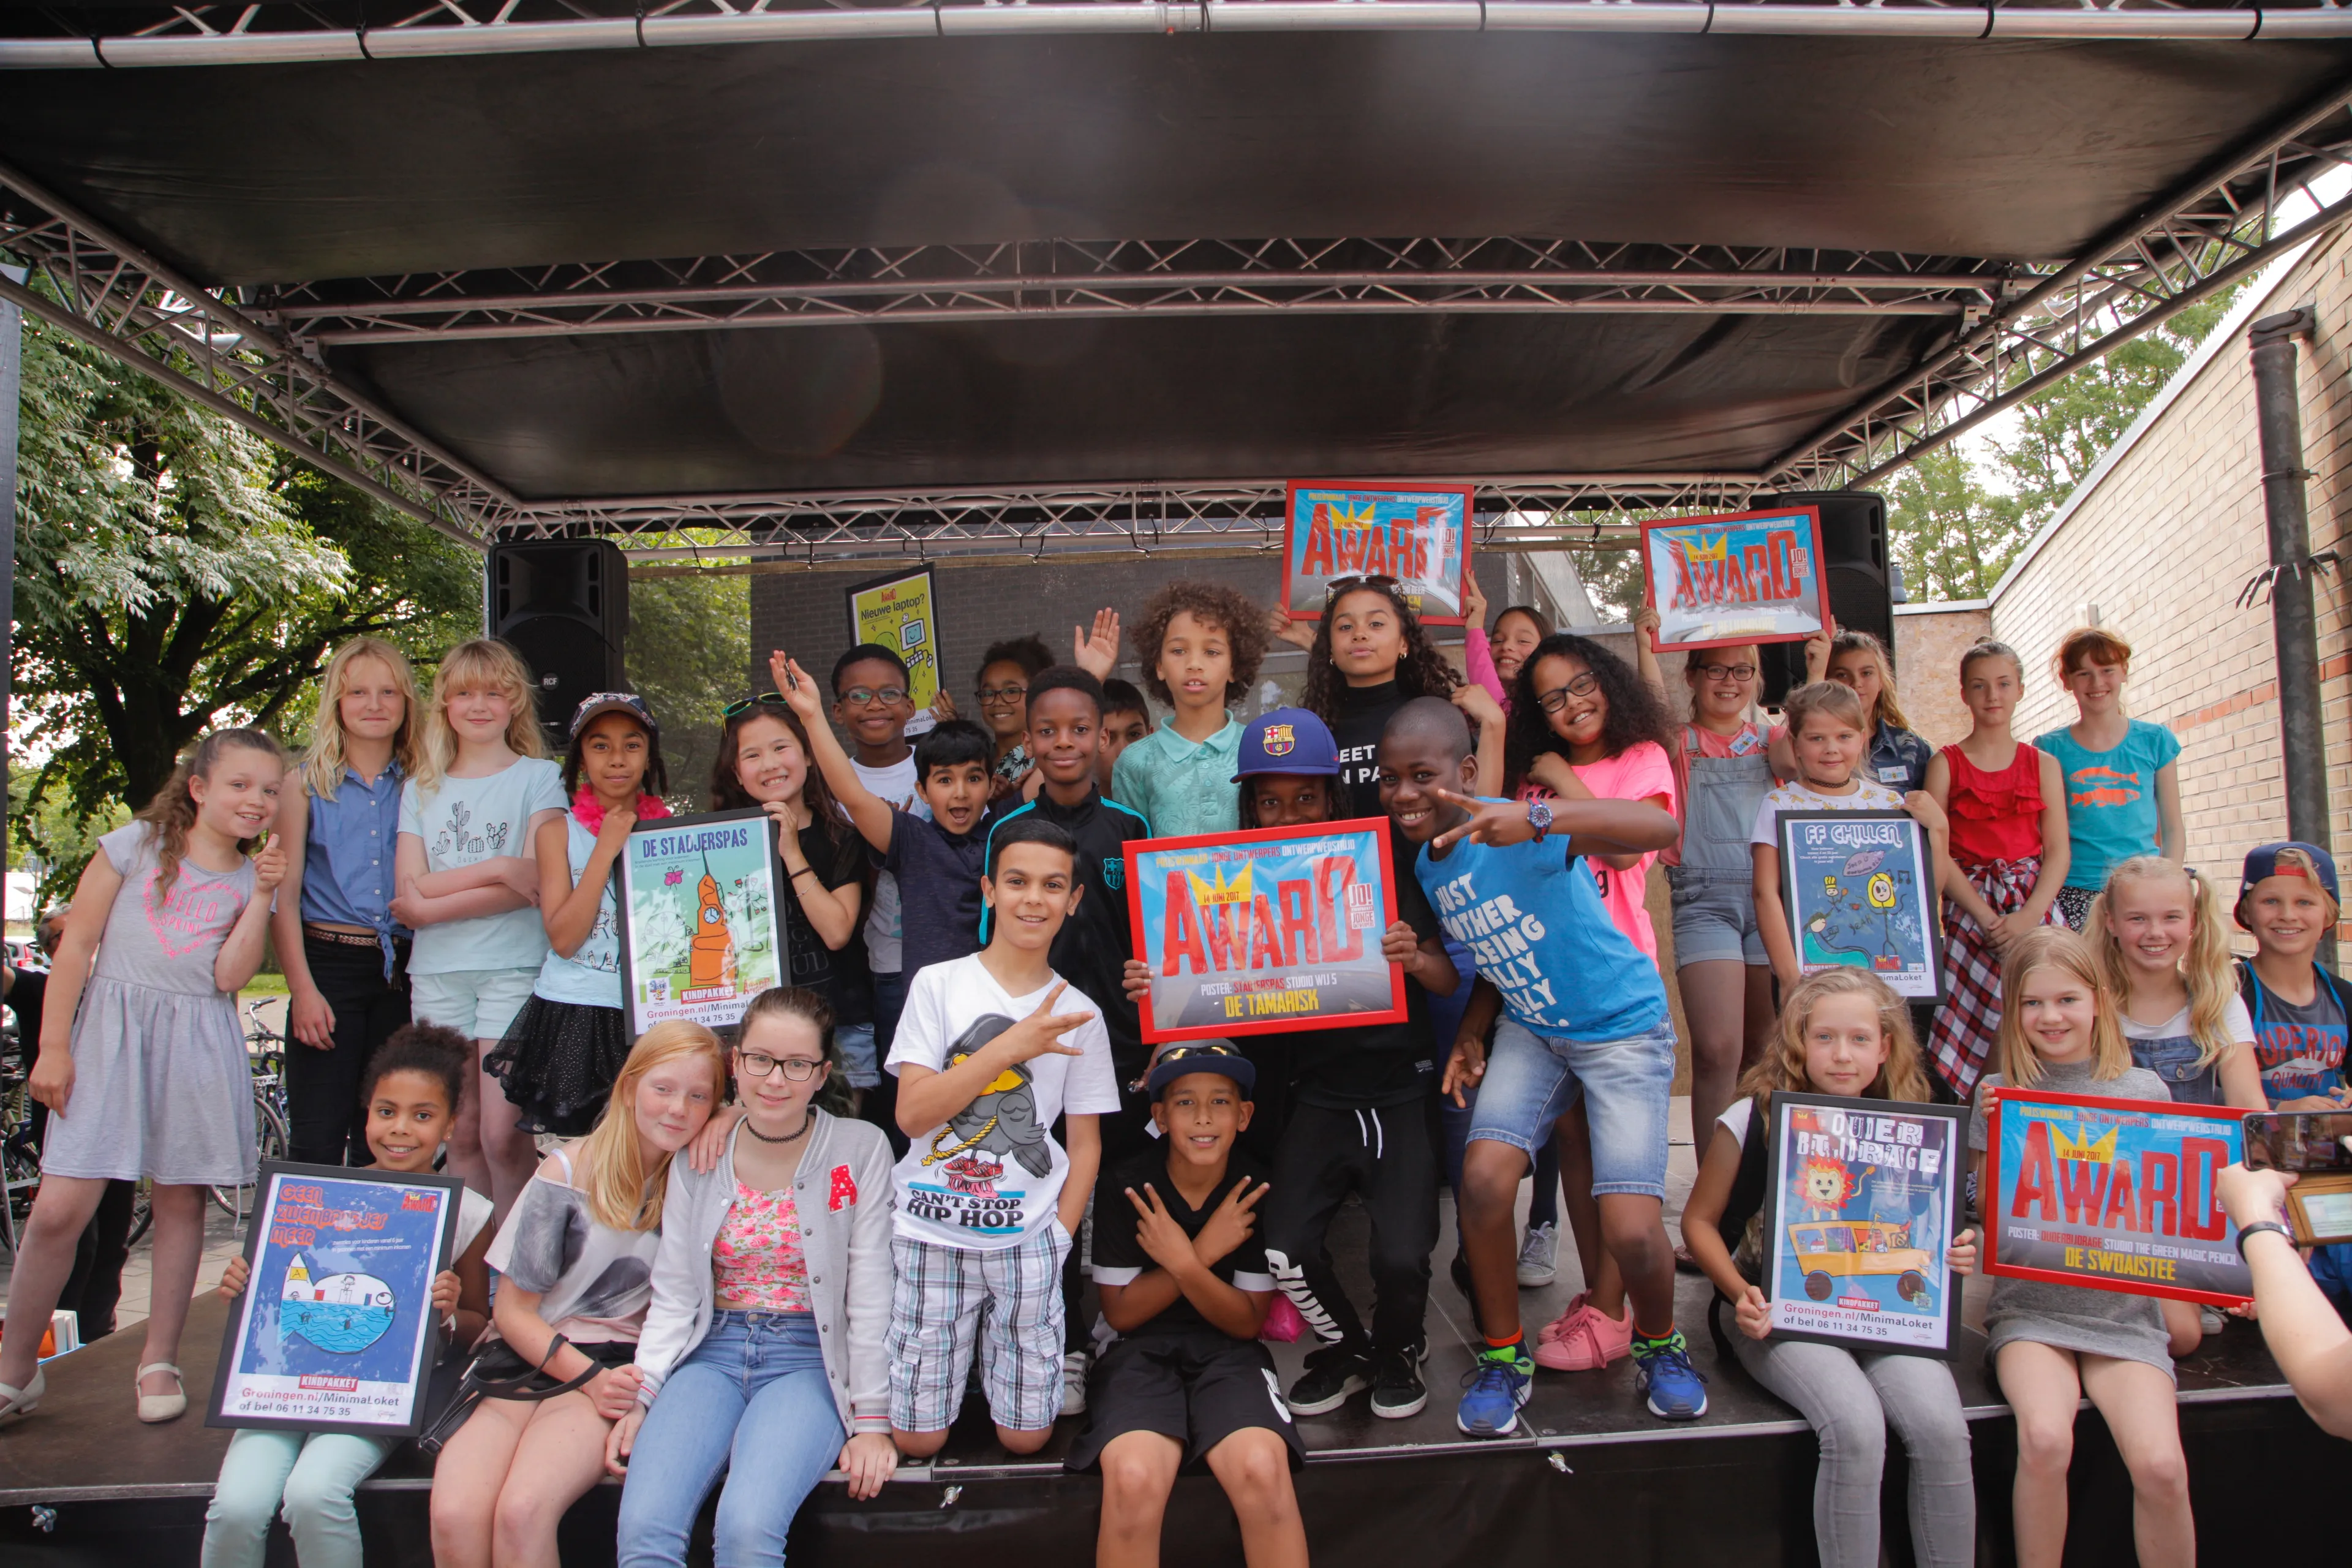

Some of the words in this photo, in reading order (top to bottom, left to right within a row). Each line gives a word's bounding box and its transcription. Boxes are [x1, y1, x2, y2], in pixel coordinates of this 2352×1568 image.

[1713, 524, 1745, 534] ONTWERPERS
[1301, 503, 1447, 579] AWARD
[1792, 549, 1806, 563] JO!
[1668, 530, 1801, 608] AWARD
[861, 605, 891, 620] Nieuwe
[893, 593, 925, 611] laptop?
[881, 588, 896, 603] AWARD
[1340, 745, 1376, 763] EET
[1359, 766, 1381, 783] PA
[643, 839, 657, 858] DE
[661, 828, 748, 856] STADJERSPAS
[1805, 824, 1826, 845] FF
[1831, 824, 1904, 848] CHILLEN
[1212, 851, 1231, 862] JONGE
[1234, 846, 1280, 861] ONTWERPERS
[1282, 839, 1355, 856] ONTWERPWEDSTRIJD
[163, 886, 218, 922] HELLO
[1204, 894, 1210, 903] 14
[1212, 893, 1224, 902] JUNI
[1226, 891, 1239, 901] 2017
[1351, 884, 1372, 906] JO!
[1435, 872, 1477, 915] JUST
[160, 912, 202, 936] SPRING
[1163, 855, 1364, 977] AWARD
[1353, 911, 1373, 923] JONGE
[1466, 914, 1545, 965] EING
[1477, 951, 1542, 989] LLY
[1875, 957, 1900, 970] AWARD
[682, 986, 734, 1001] KINDPAKKET
[1201, 982, 1232, 996] POSTER:
[1286, 975, 1314, 989] STUDIO
[1316, 973, 1330, 986] WIJ
[1331, 973, 1337, 985] 5
[1224, 995, 1244, 1017] DE
[1246, 989, 1319, 1016] TAMARISK
[2255, 1025, 2346, 1071] UPERIO
[2271, 1071, 2324, 1091] QUALITY
[1831, 1113, 1924, 1147] OUDER
[2075, 1112, 2097, 1123] JONGE
[2100, 1114, 2149, 1128] ONTWERPERS
[2151, 1118, 2232, 1136] ONTWERPWEDSTRIJD
[2063, 1148, 2070, 1158] 14
[2071, 1150, 2085, 1159] JUNI
[2087, 1151, 2100, 1160] 2017
[828, 1163, 858, 1214] A
[2011, 1121, 2229, 1242] AWARD
[280, 1184, 324, 1208] GEEN
[401, 1194, 437, 1212] AWARD
[911, 1189, 964, 1207] CAN'T
[968, 1197, 1021, 1210] STOP
[907, 1199, 952, 1222] HIP
[959, 1210, 1024, 1227] HOP
[270, 1226, 316, 1248] MEER
[2008, 1226, 2039, 1241] POSTER:
[2041, 1231, 2102, 1248] OUDERBIJDRAGE
[2104, 1238, 2133, 1253] STUDIO
[2135, 1242, 2150, 1254] THE
[2152, 1244, 2179, 1259] GREEN
[2180, 1248, 2207, 1262] MAGIC
[2208, 1251, 2237, 1266] PENCIL
[293, 1269, 301, 1279] A
[2065, 1246, 2084, 1268] DE
[2087, 1250, 2176, 1281] SWOAISTEE
[1839, 1298, 1879, 1310] KINDPAKKET
[1784, 1303, 1932, 1329] Groningen.nl/MinimaLoket
[1798, 1317, 1814, 1327] bel
[1862, 1325, 1872, 1334] 75
[301, 1376, 357, 1389] KINDPAKKET
[239, 1401, 252, 1411] of
[254, 1401, 272, 1412] bel
[276, 1404, 288, 1413] 06
[293, 1405, 303, 1414] 11
[307, 1406, 319, 1415] 34
[323, 1406, 335, 1415] 75
[339, 1408, 351, 1416] 35
[242, 1388, 400, 1406] Groningen.nl/MinimaLoket
